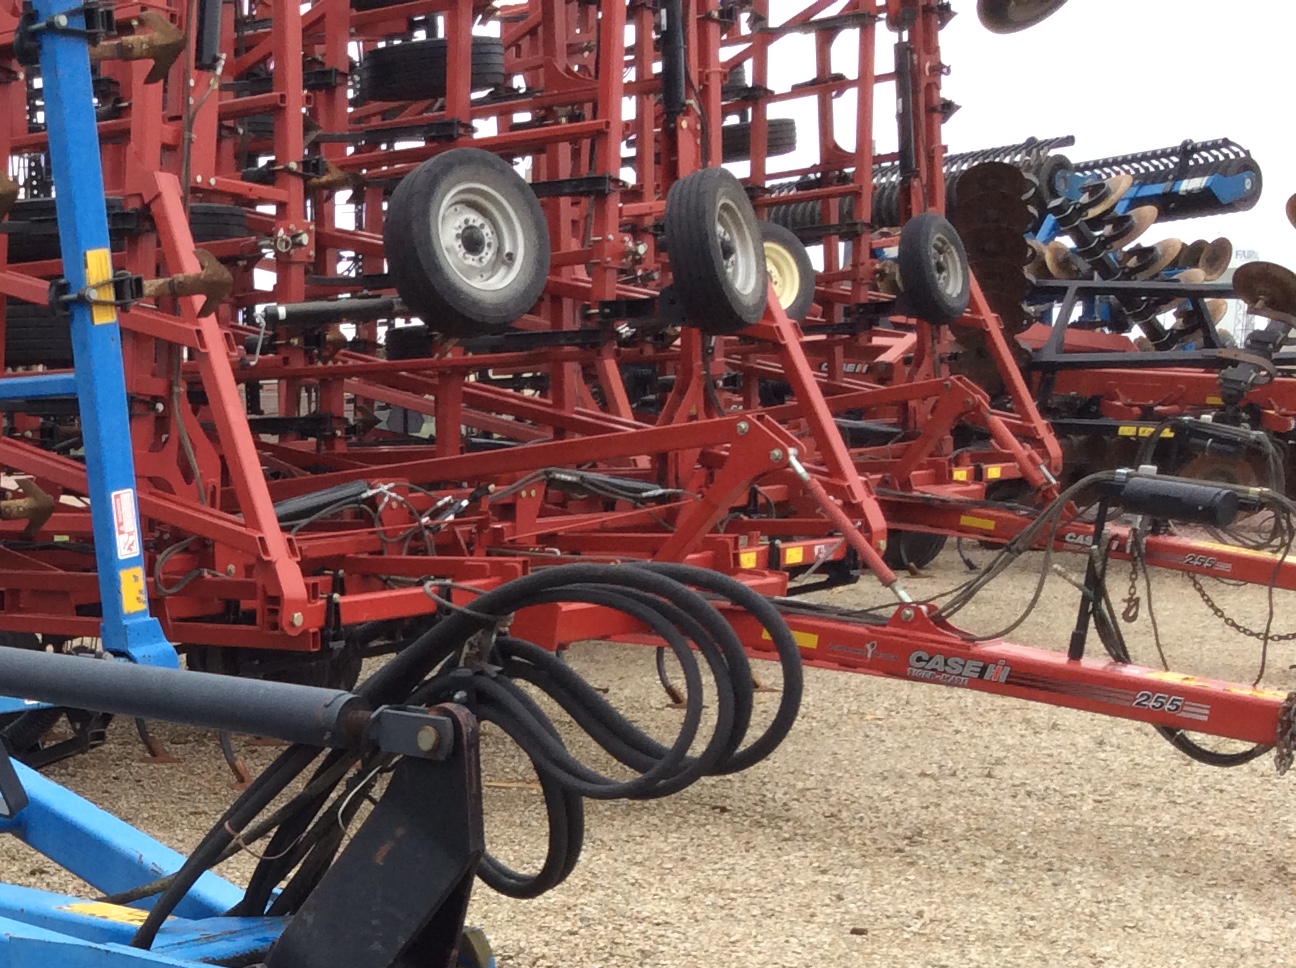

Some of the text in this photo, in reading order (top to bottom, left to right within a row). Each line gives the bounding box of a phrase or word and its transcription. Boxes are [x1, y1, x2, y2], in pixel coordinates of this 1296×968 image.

[1183, 553, 1217, 569] 255
[908, 650, 984, 678] CASE
[1132, 690, 1185, 714] 255
